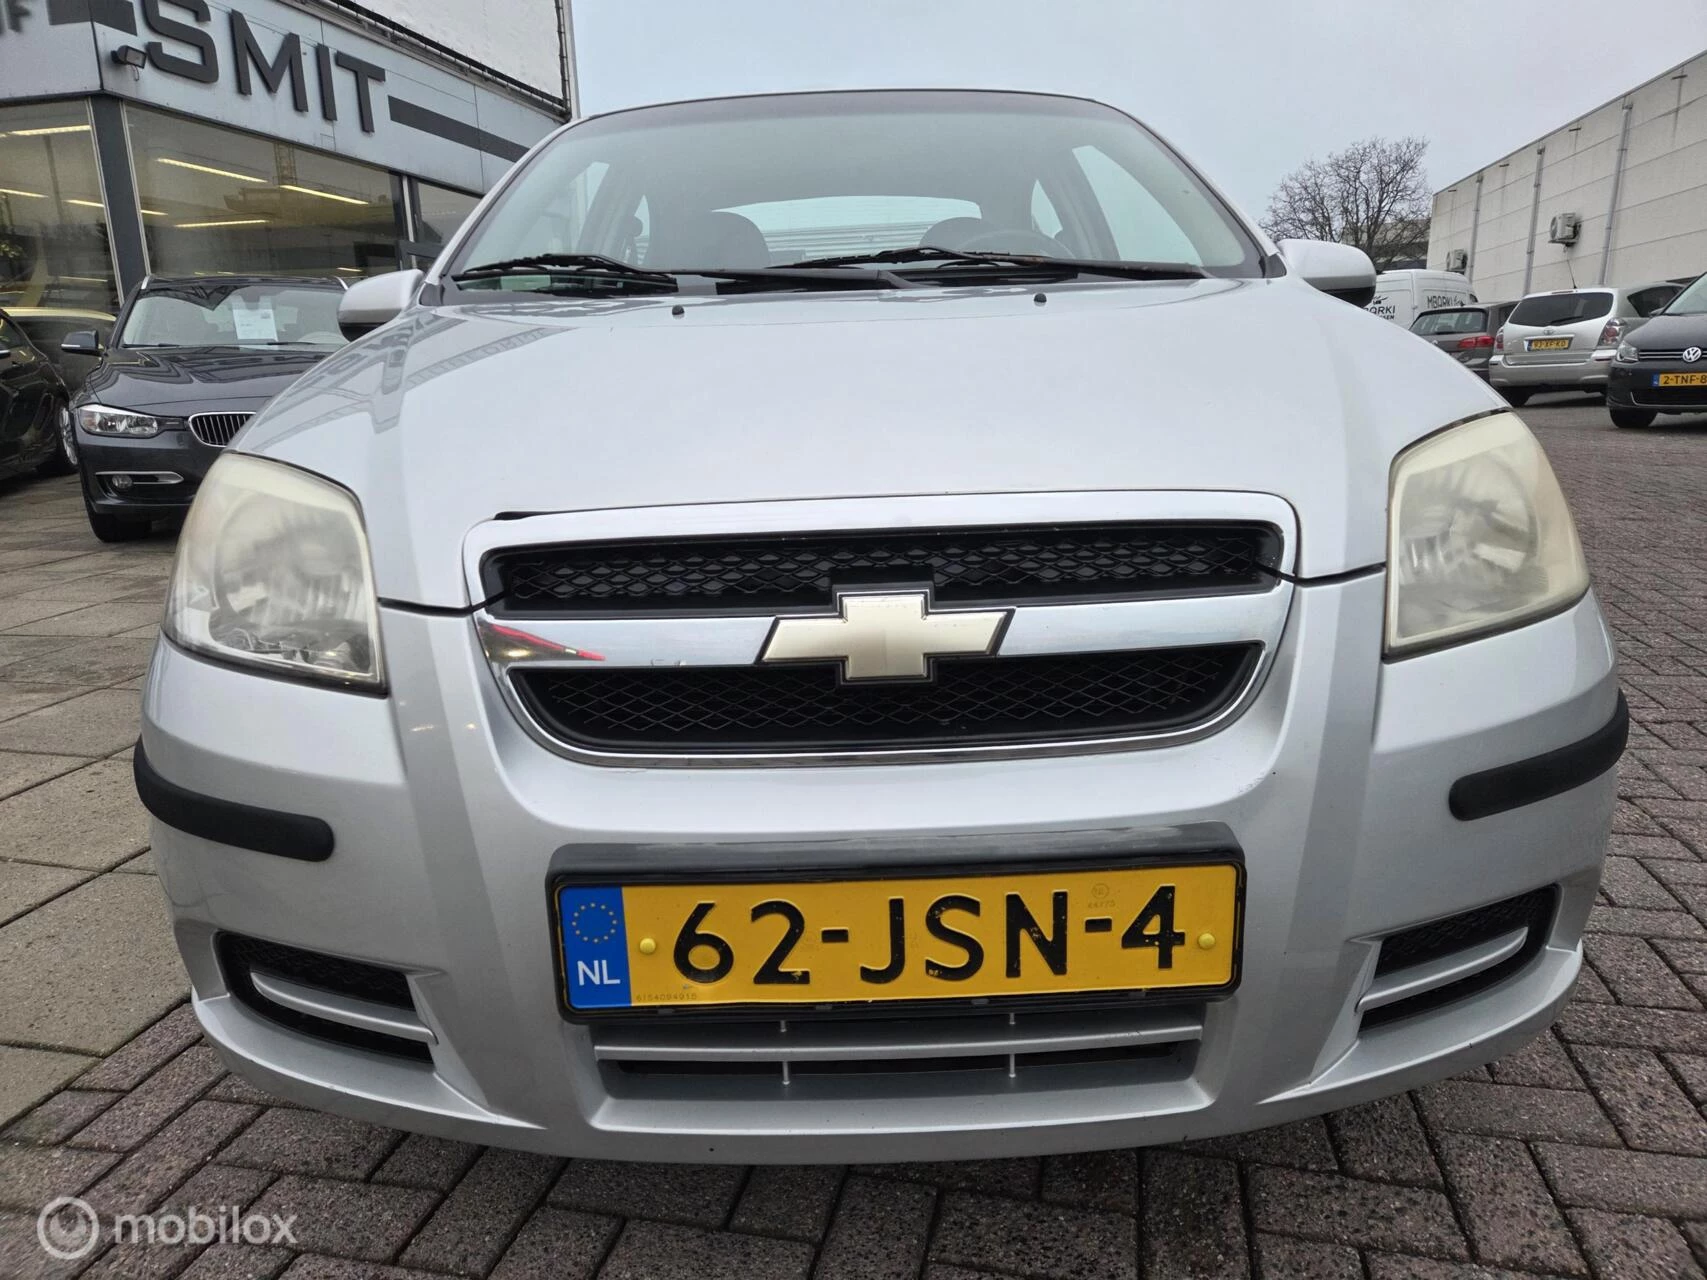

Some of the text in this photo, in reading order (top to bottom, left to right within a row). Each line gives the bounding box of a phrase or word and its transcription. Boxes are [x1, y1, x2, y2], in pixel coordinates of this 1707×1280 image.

[142, 0, 386, 133] SMIT
[577, 959, 621, 986] NL
[673, 885, 1186, 985] 62-JSN-4
